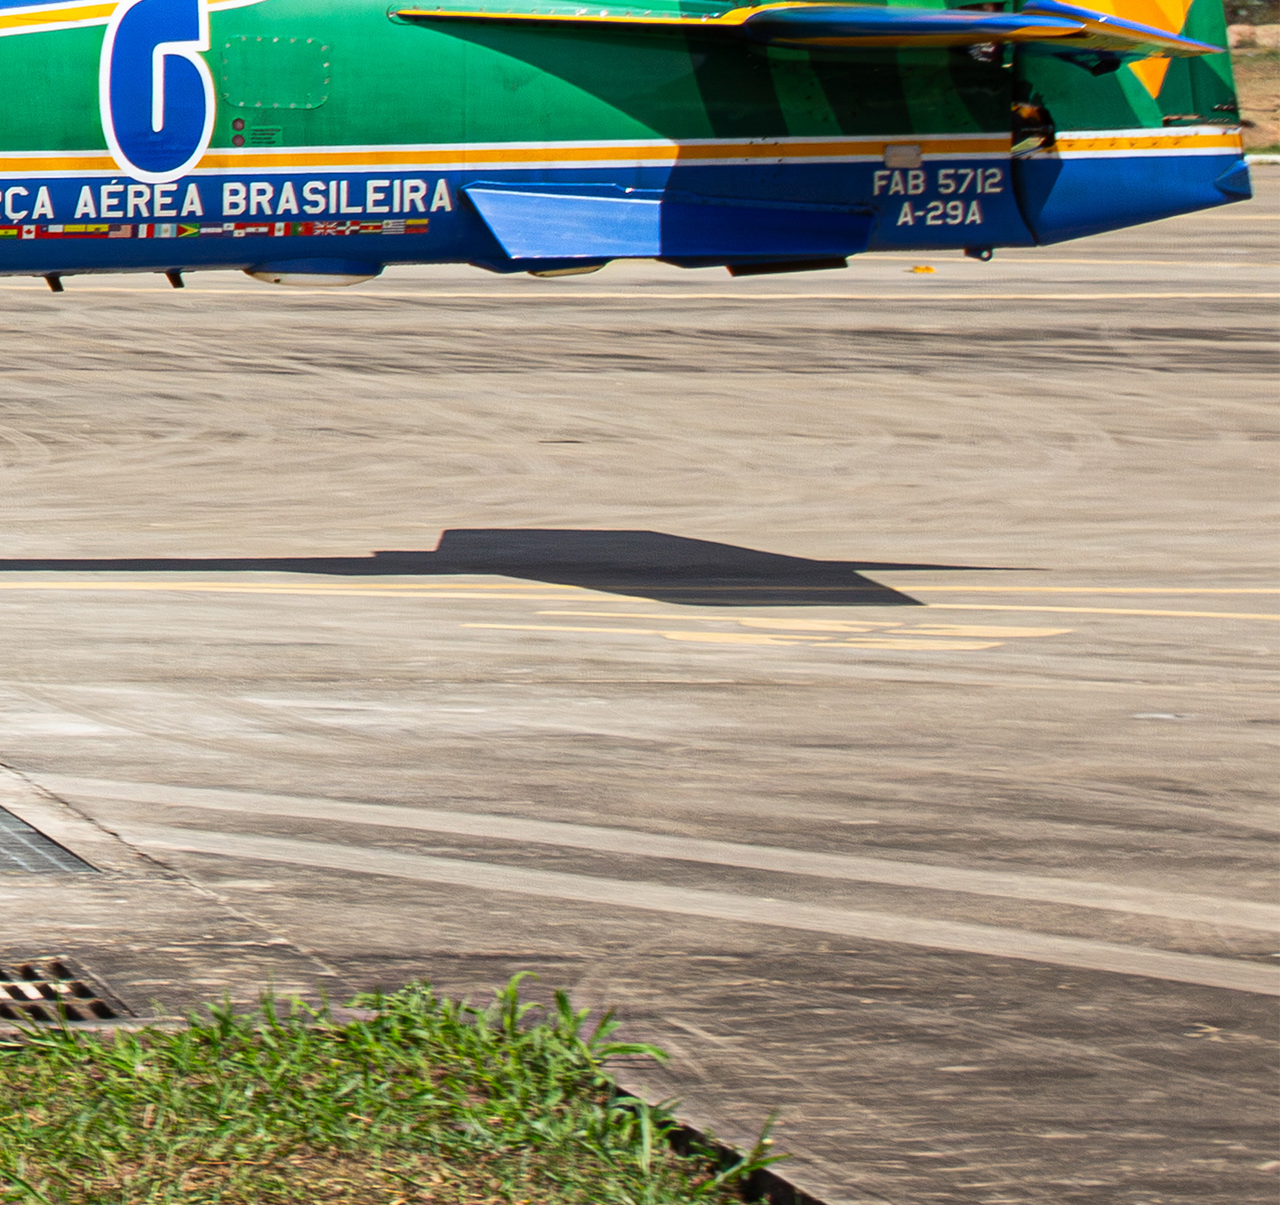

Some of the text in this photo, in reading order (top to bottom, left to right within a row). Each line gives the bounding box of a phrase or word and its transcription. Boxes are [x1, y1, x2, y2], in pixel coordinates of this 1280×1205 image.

[873, 167, 1003, 196] FAB 5712
[73, 179, 204, 220] AÉREA
[222, 179, 453, 216] BRASILEIRA
[896, 200, 983, 226] A-29A
